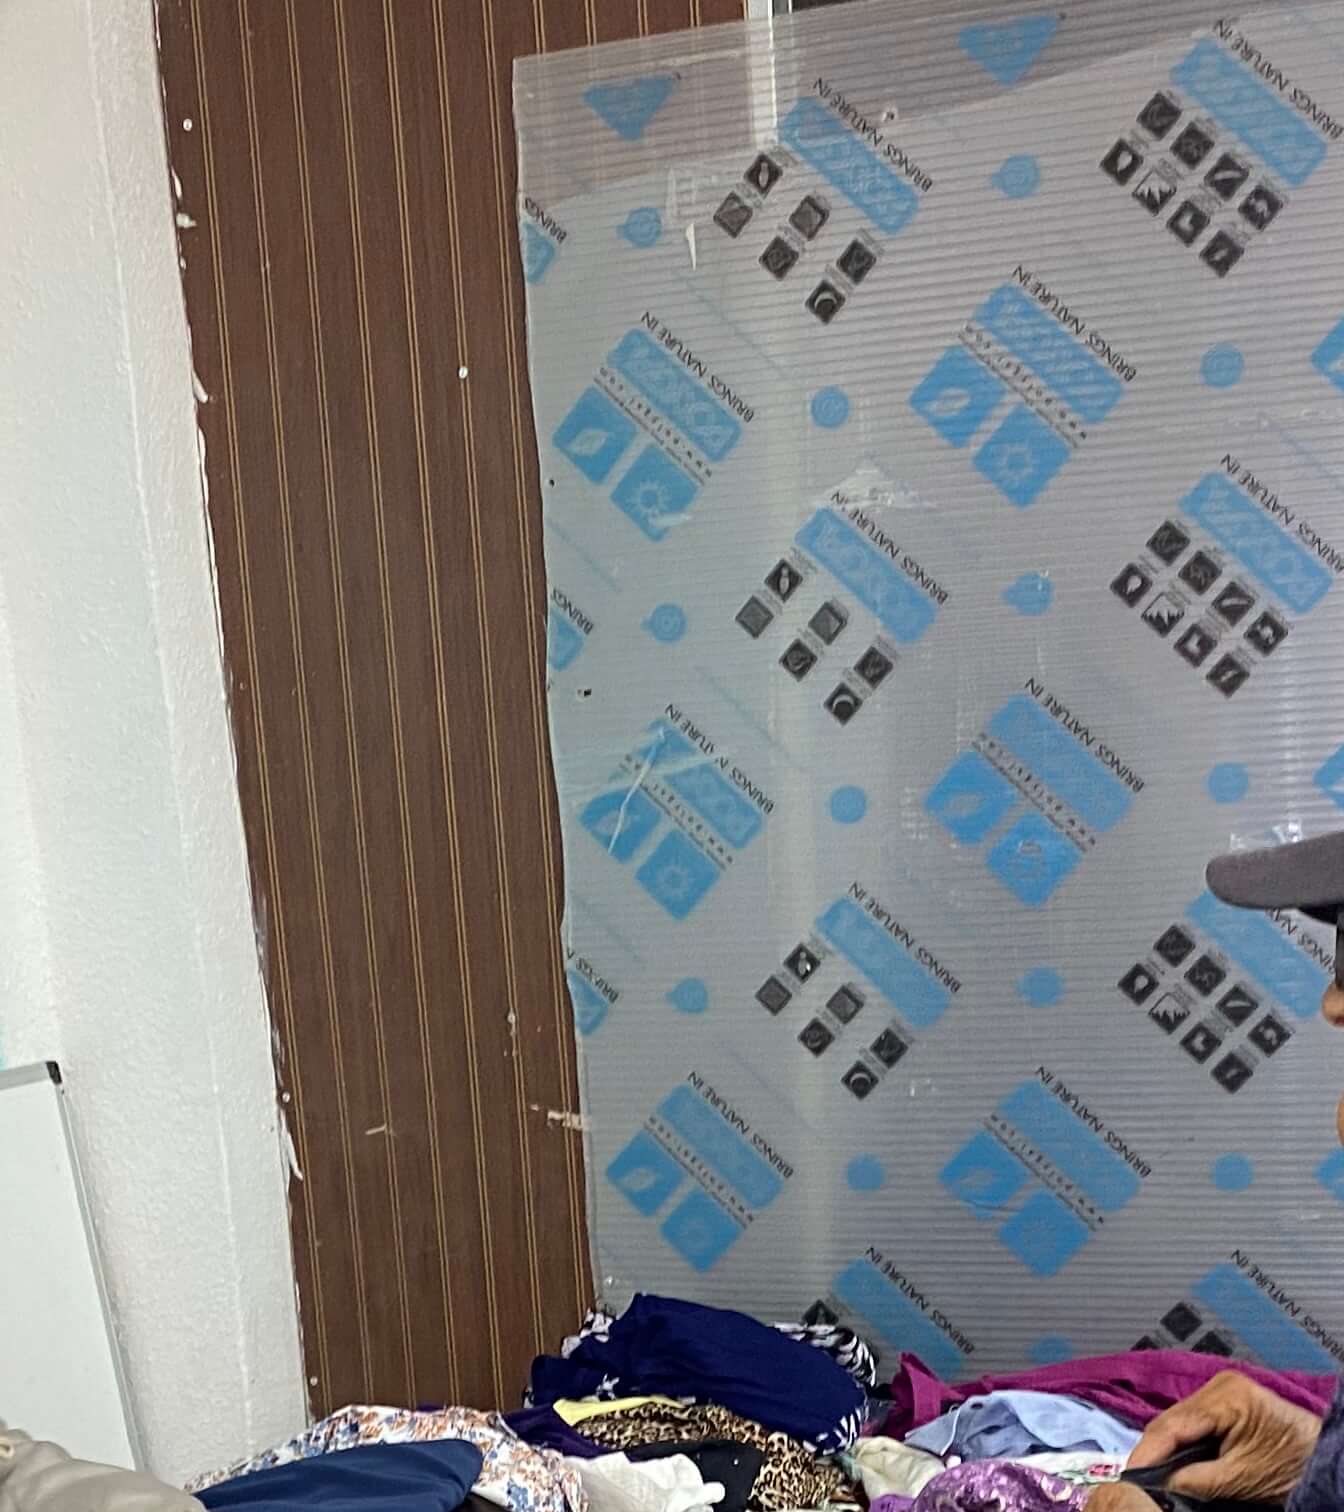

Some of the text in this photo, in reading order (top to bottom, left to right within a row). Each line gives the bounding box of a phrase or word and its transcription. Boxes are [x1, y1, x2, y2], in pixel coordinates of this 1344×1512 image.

[1211, 17, 1344, 140] BRINGS NATURE IN
[811, 77, 933, 192] BRINGS NATURE IN
[520, 195, 567, 242] BRINGS
[1010, 264, 1137, 382] BRINGS NATURE IN
[639, 310, 755, 422] BRINGS NATURE IN
[1219, 453, 1241, 474] IN
[1239, 471, 1295, 524] NATURE
[848, 506, 900, 558] NATURE
[898, 555, 948, 604] BRINGS
[548, 587, 594, 633] BRINGS
[1023, 677, 1044, 697] IN
[663, 703, 682, 722] IN
[1041, 695, 1096, 746] NATURE
[727, 767, 775, 813] BRINGS
[1092, 743, 1145, 792] BRINGS
[846, 882, 962, 992] BRINGS NATURE IN
[686, 1071, 704, 1089] IN
[1034, 1065, 1054, 1084] IN
[701, 1086, 750, 1134] NATURE
[1050, 1081, 1104, 1133] NATURE
[748, 1132, 794, 1178] BRINGS
[1101, 1130, 1152, 1178] BRINGS
[1229, 1248, 1249, 1268] IN
[864, 1246, 975, 1354] BRINGS NATURE IN
[1248, 1265, 1300, 1316] NATURE
